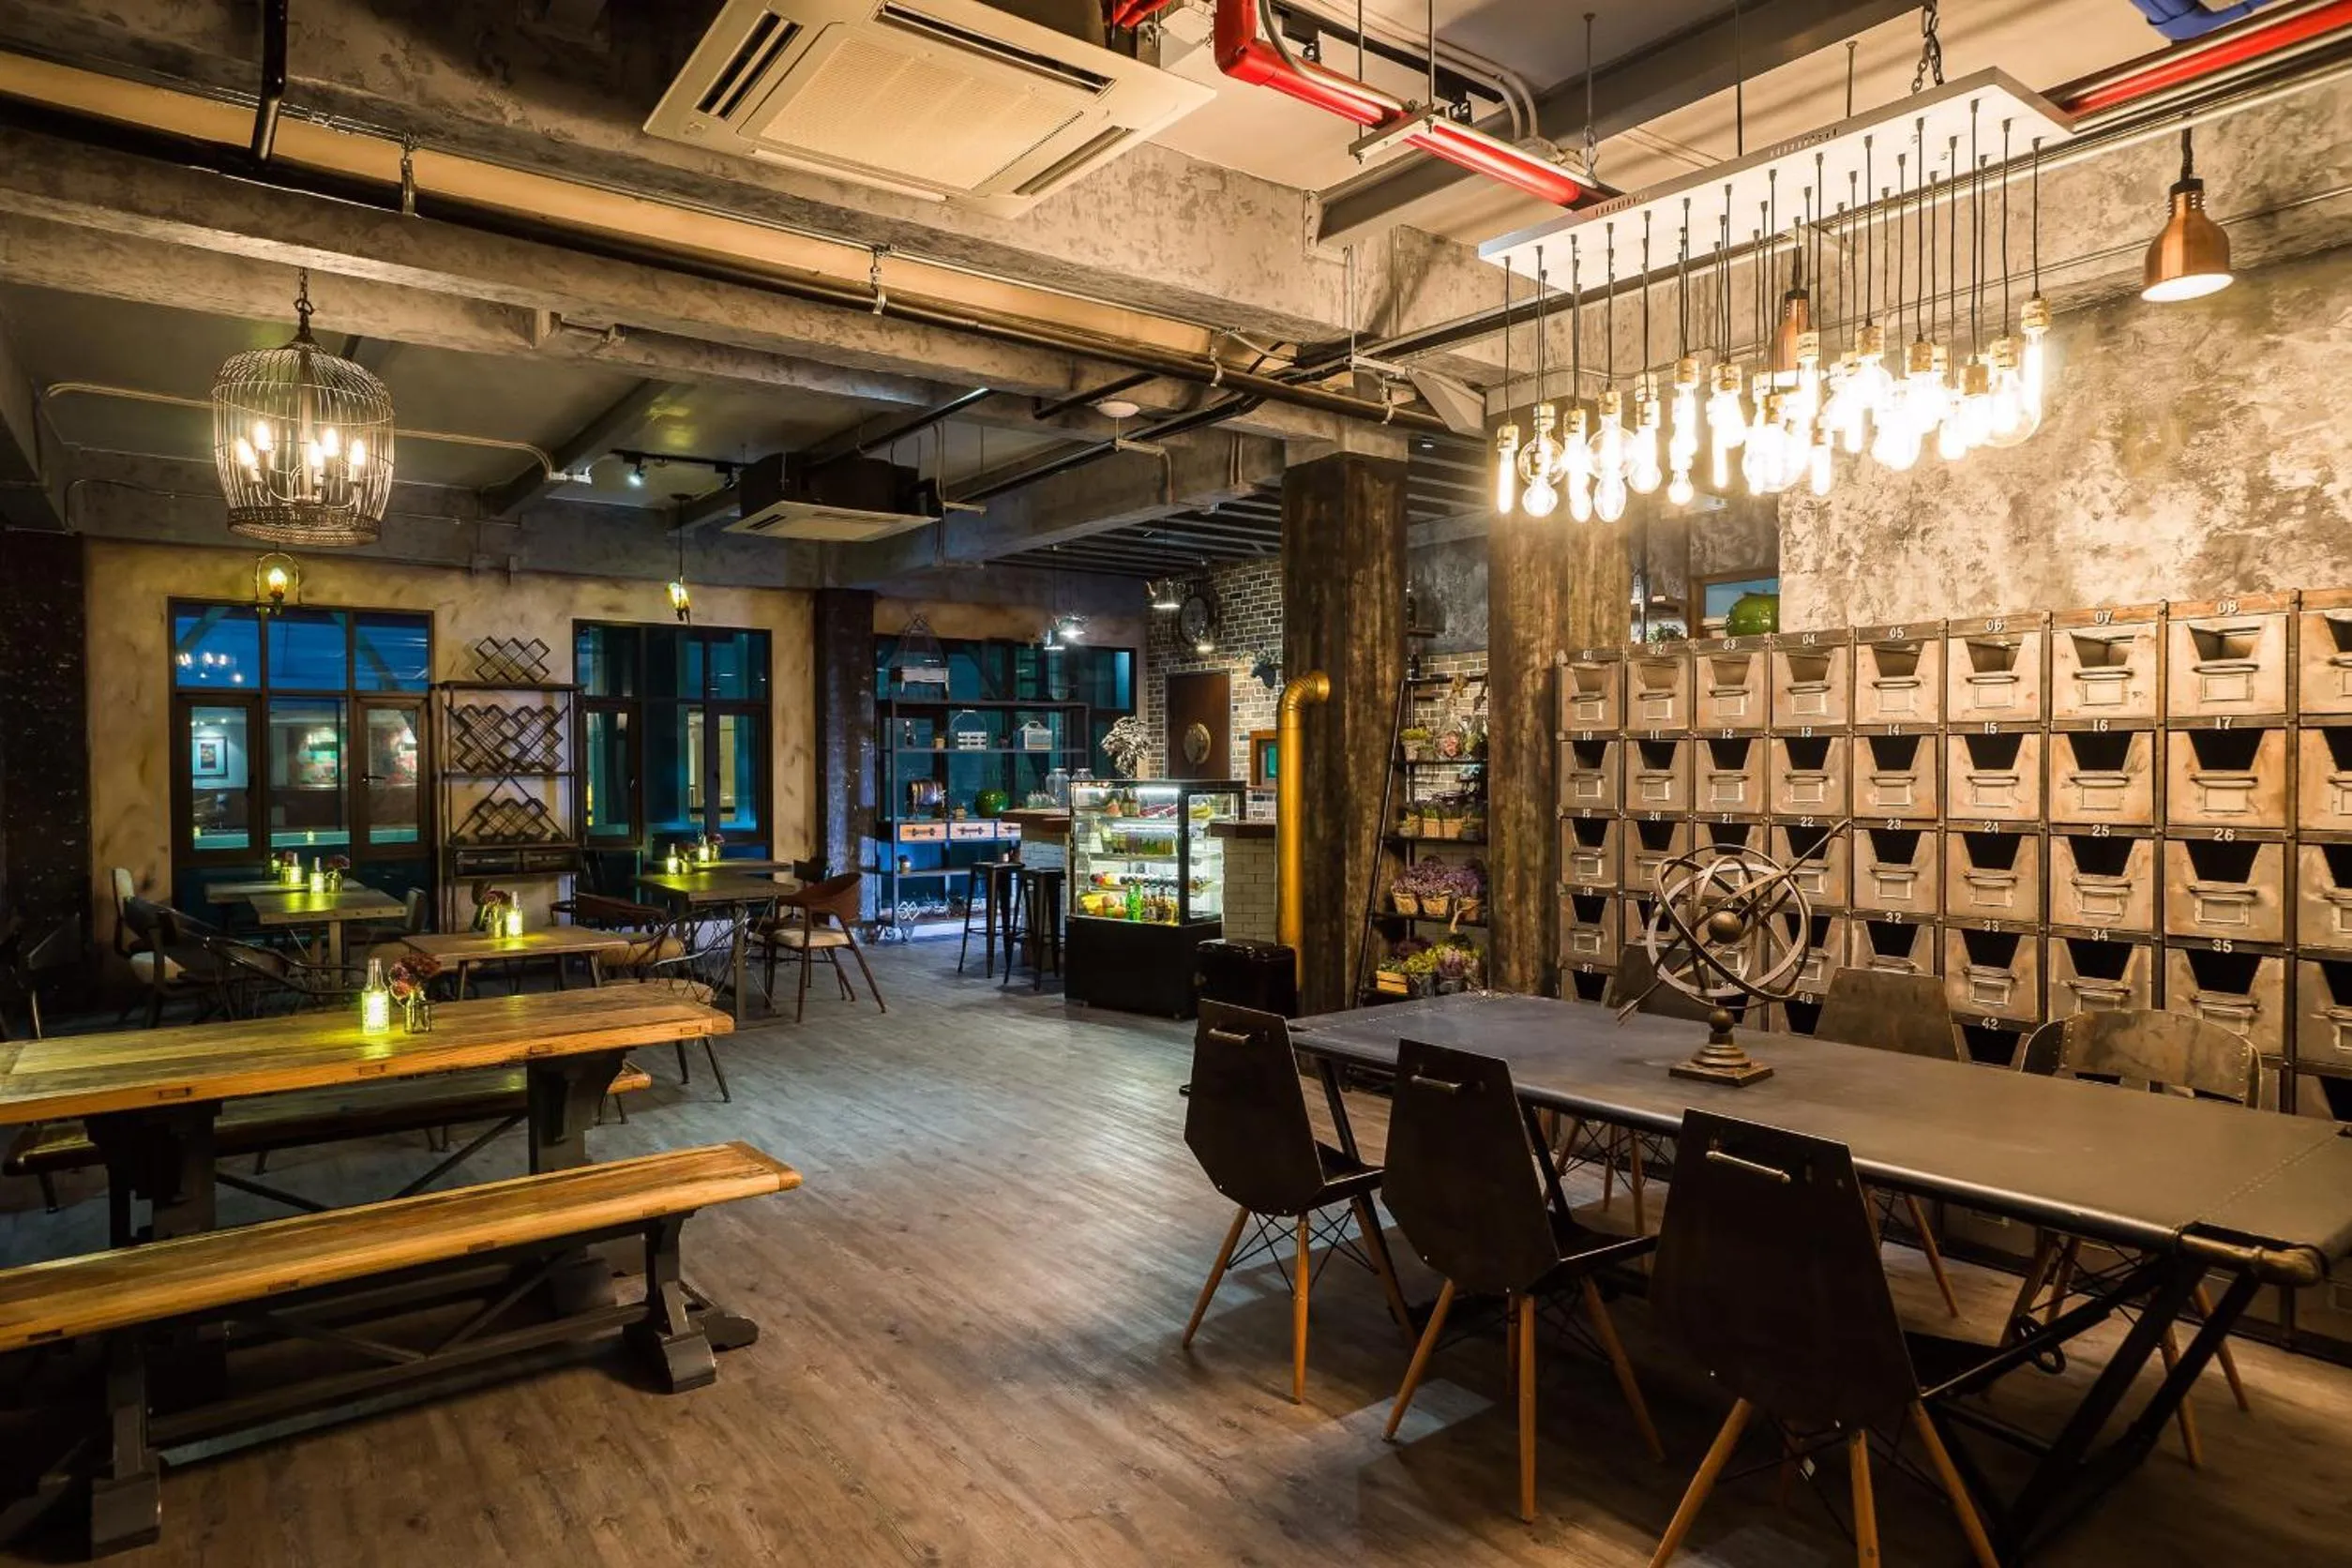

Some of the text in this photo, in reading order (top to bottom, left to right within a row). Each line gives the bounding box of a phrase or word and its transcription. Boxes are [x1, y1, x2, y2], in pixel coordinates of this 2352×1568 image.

[2218, 600, 2238, 614] 08
[2096, 611, 2112, 623] 07
[1985, 619, 2003, 631] 06
[1890, 626, 1905, 639] 05
[1802, 633, 1816, 645] 04
[1984, 722, 1998, 734] 15
[2092, 719, 2108, 731] 16
[2215, 716, 2232, 729] 17
[1650, 730, 1660, 740] 11
[1722, 728, 1733, 739] 12
[1801, 727, 1813, 737] 13
[1888, 724, 1900, 735] 14
[1649, 811, 1661, 821] 20
[1722, 813, 1732, 823] 21
[1801, 817, 1815, 827] 22
[1887, 819, 1902, 830] 23
[1983, 822, 1998, 834] 24
[2092, 824, 2110, 837] 25
[2213, 827, 2235, 841] 26
[1885, 912, 1902, 924] 32
[1983, 920, 1999, 932] 33
[2091, 928, 2108, 942] 34
[2212, 939, 2233, 953] 35
[1799, 993, 1813, 1004] 40
[1982, 1017, 1998, 1031] 42
